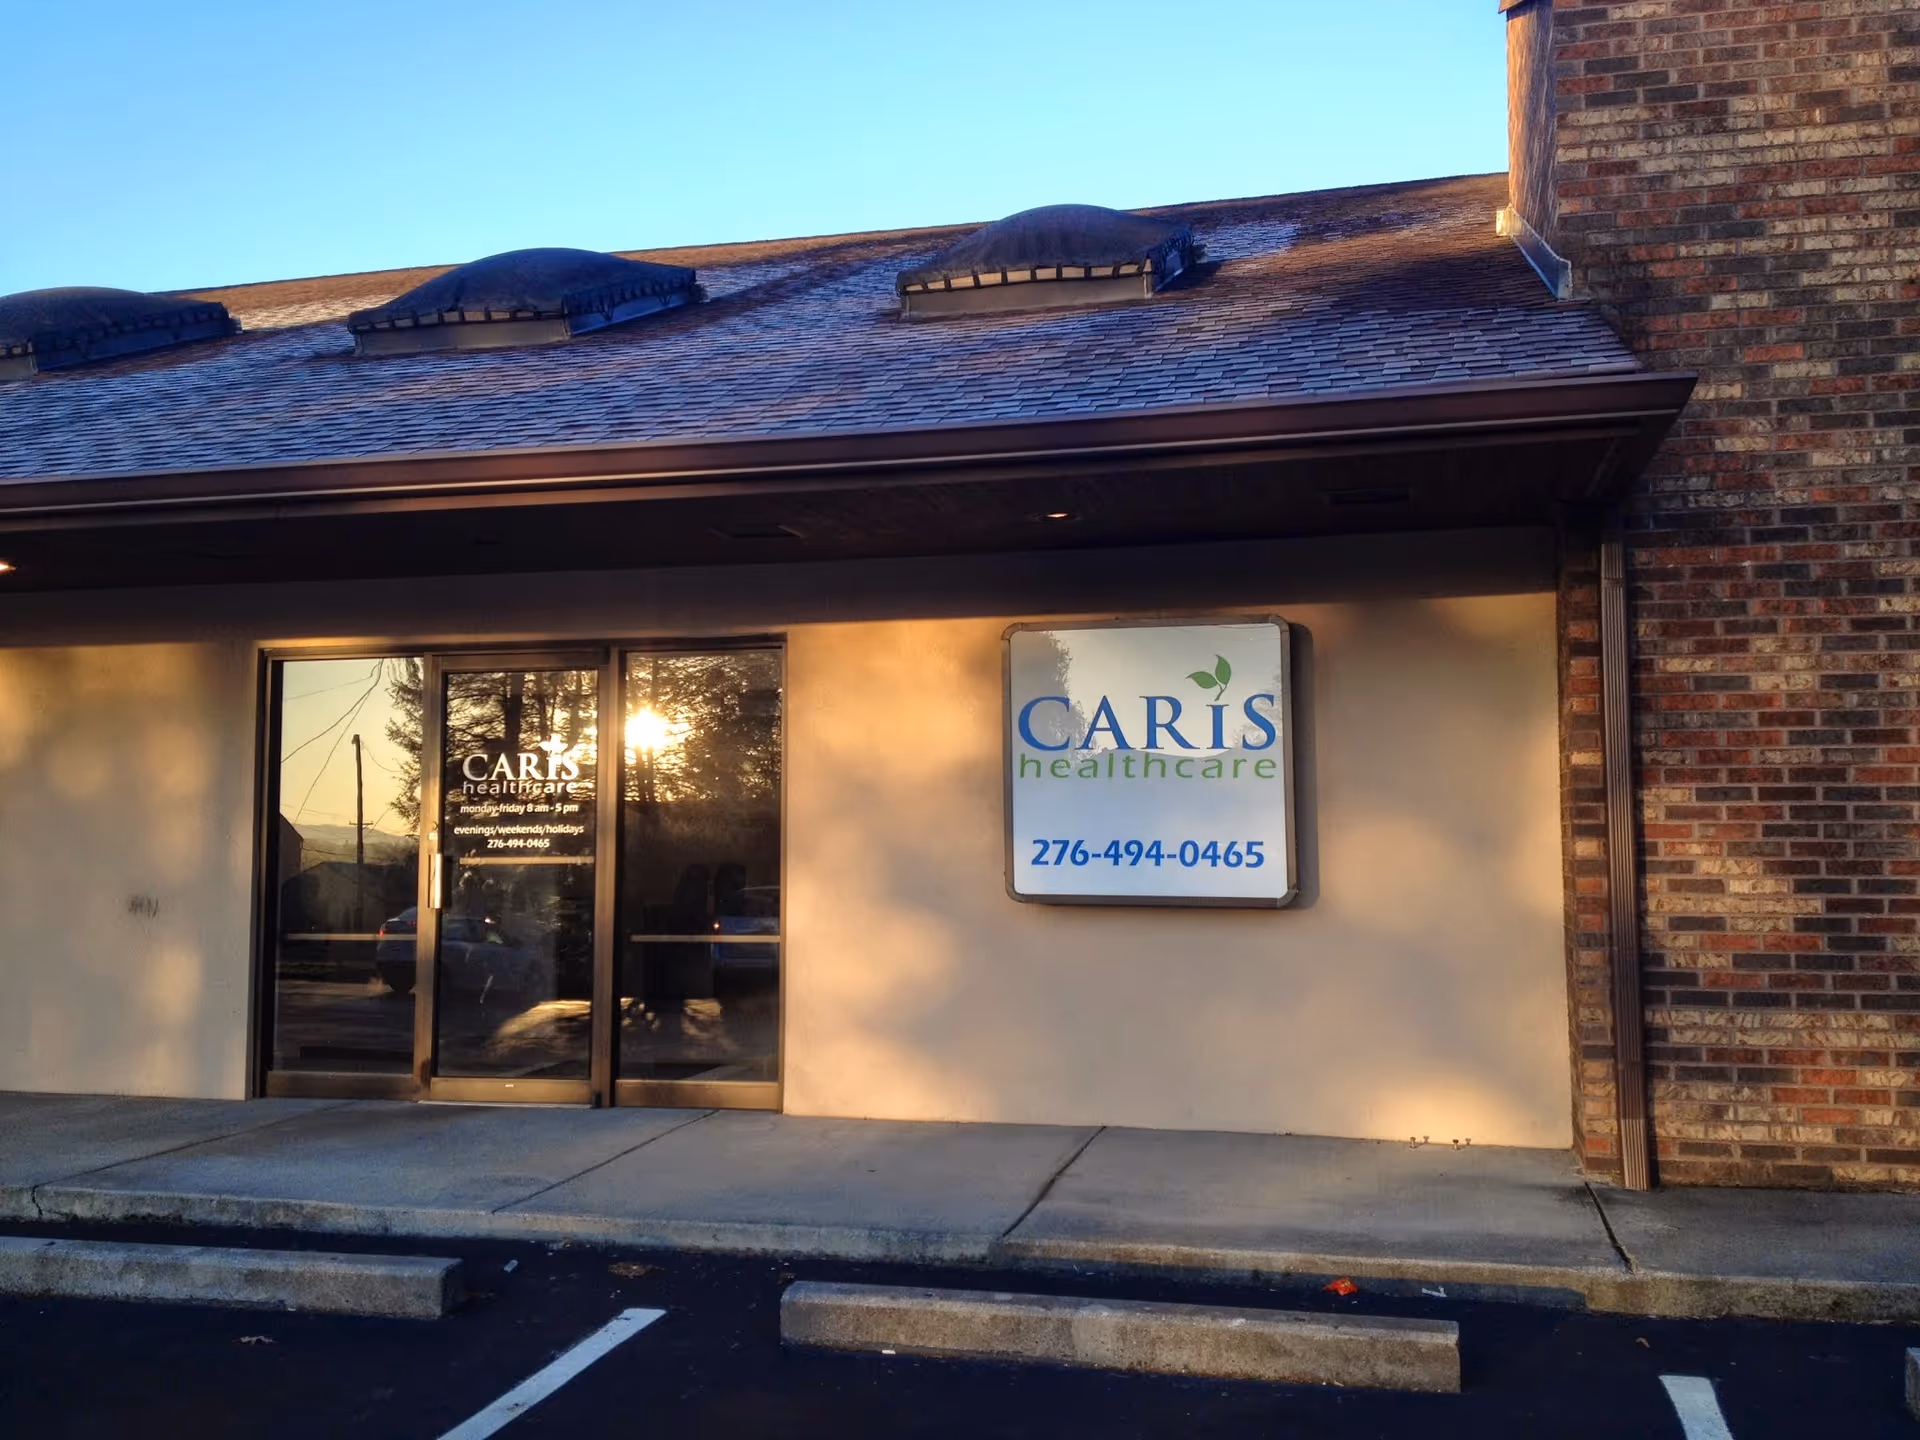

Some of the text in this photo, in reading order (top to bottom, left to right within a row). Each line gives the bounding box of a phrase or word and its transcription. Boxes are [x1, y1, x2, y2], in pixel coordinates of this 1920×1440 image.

[1018, 694, 1277, 751] CARIS
[462, 752, 580, 781] CARIS
[1019, 753, 1277, 779] healthcare
[463, 781, 577, 794] healthcare
[460, 803, 526, 816] monday-friday
[526, 803, 533, 813] 8
[534, 805, 549, 813] am
[555, 803, 562, 813] 5
[563, 805, 579, 815] pm
[487, 838, 551, 849] 276-494-0465
[1031, 839, 1265, 868] 276-494-0465
